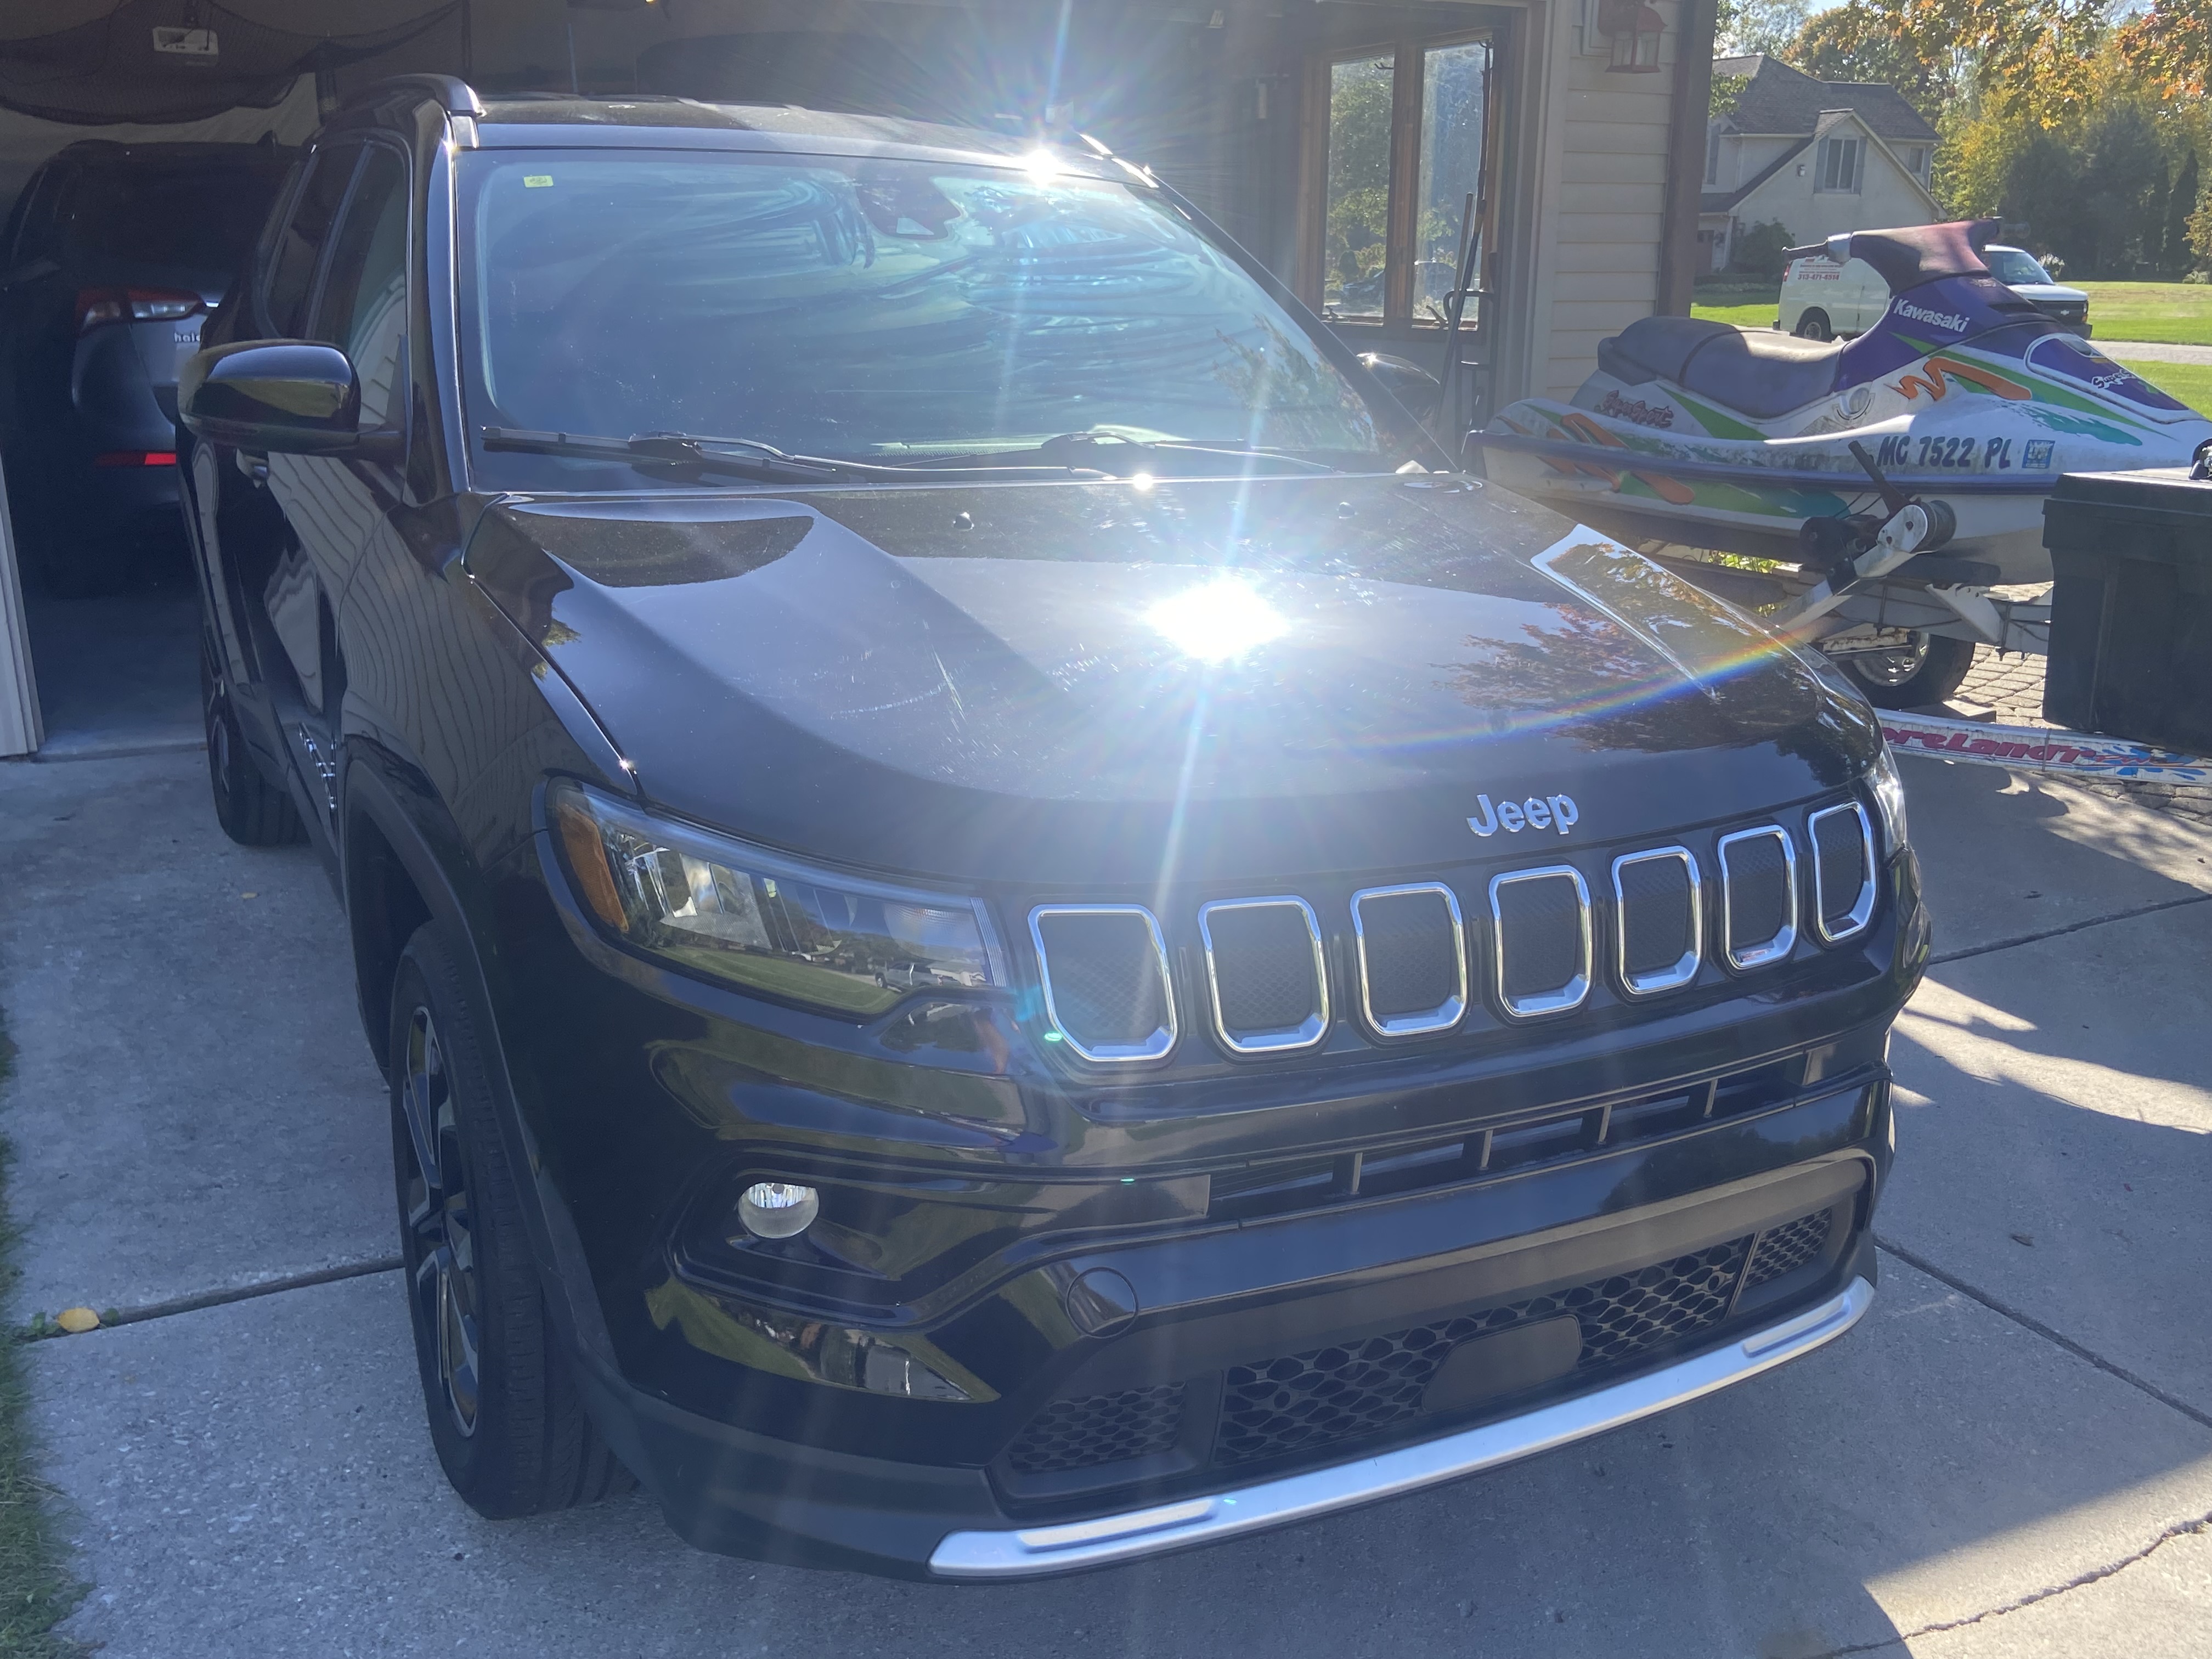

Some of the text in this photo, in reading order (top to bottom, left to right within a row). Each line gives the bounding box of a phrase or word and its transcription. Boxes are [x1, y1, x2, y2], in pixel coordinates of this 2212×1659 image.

[1893, 298, 1970, 332] Kawasaki
[1877, 436, 1910, 466] MC
[1918, 436, 1975, 467] 7522
[1984, 437, 2011, 469] PL
[1466, 794, 1579, 837] Jeep
